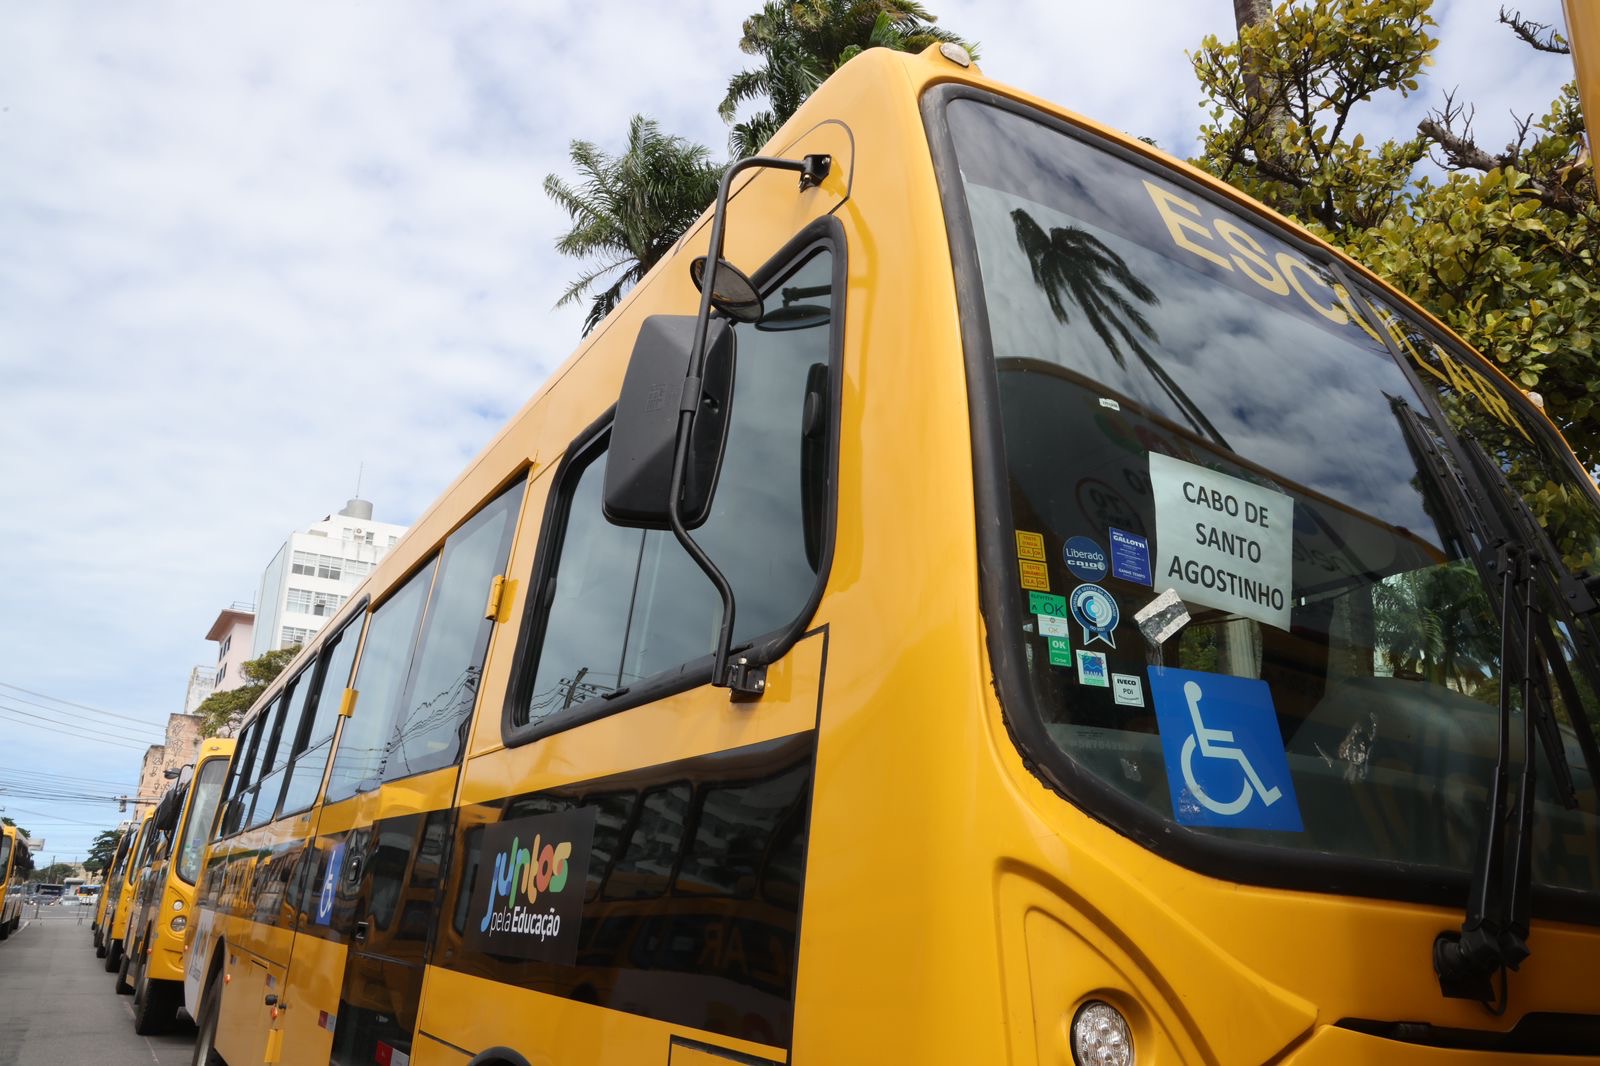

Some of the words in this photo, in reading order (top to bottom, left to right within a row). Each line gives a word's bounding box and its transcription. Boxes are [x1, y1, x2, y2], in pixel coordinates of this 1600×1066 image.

[1183, 481, 1238, 517] CABO
[1245, 501, 1270, 529] DE
[1066, 547, 1104, 561] Liberado
[1113, 535, 1145, 548] GALLOTTI
[1195, 522, 1261, 564] SANTO
[1168, 555, 1284, 611] AGOSTINHO
[1043, 602, 1065, 617] OK
[1052, 640, 1066, 649] OK
[1116, 678, 1137, 686] IVECO
[480, 833, 572, 932] juntos
[489, 906, 512, 937] pela
[511, 906, 560, 942] Educação
